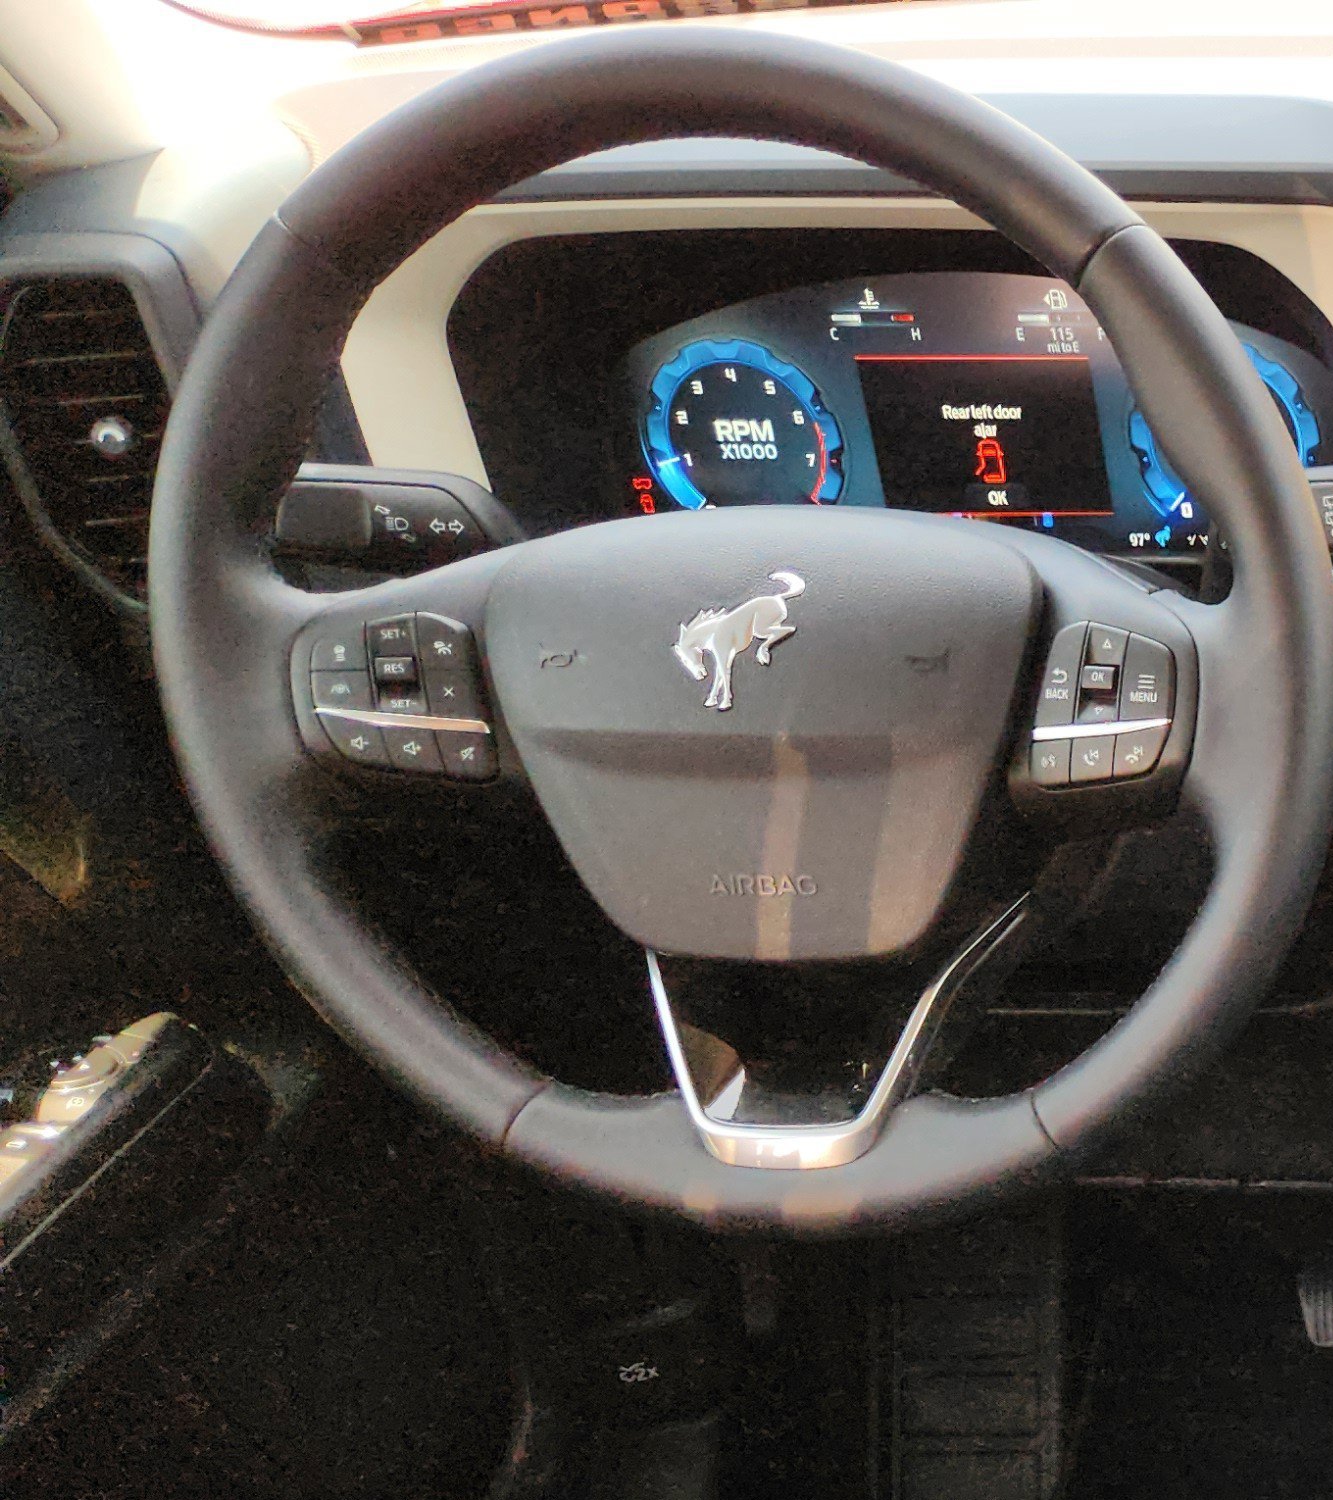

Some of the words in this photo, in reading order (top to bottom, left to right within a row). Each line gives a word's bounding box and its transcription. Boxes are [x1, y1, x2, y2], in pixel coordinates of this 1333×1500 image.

[829, 327, 840, 341] C
[910, 327, 922, 341] H
[1015, 327, 1026, 341] E
[1049, 327, 1074, 341] 115
[724, 367, 737, 382] 4
[690, 380, 704, 395] 3
[763, 380, 776, 395] 5
[675, 410, 689, 425] 2
[792, 410, 805, 425] 6
[942, 404, 969, 420] Rear
[970, 404, 993, 420] left
[993, 404, 1022, 420] door
[713, 418, 776, 442] RPM
[974, 422, 997, 439] ajar
[719, 443, 778, 460] X1000
[682, 453, 693, 467] 1
[805, 453, 816, 467] 7
[987, 490, 1009, 506] OK
[383, 663, 405, 674] RES
[1091, 672, 1105, 682] OK
[1045, 688, 1069, 700] BACK
[1130, 692, 1158, 703] MENU
[710, 873, 819, 897] AIRBAG
